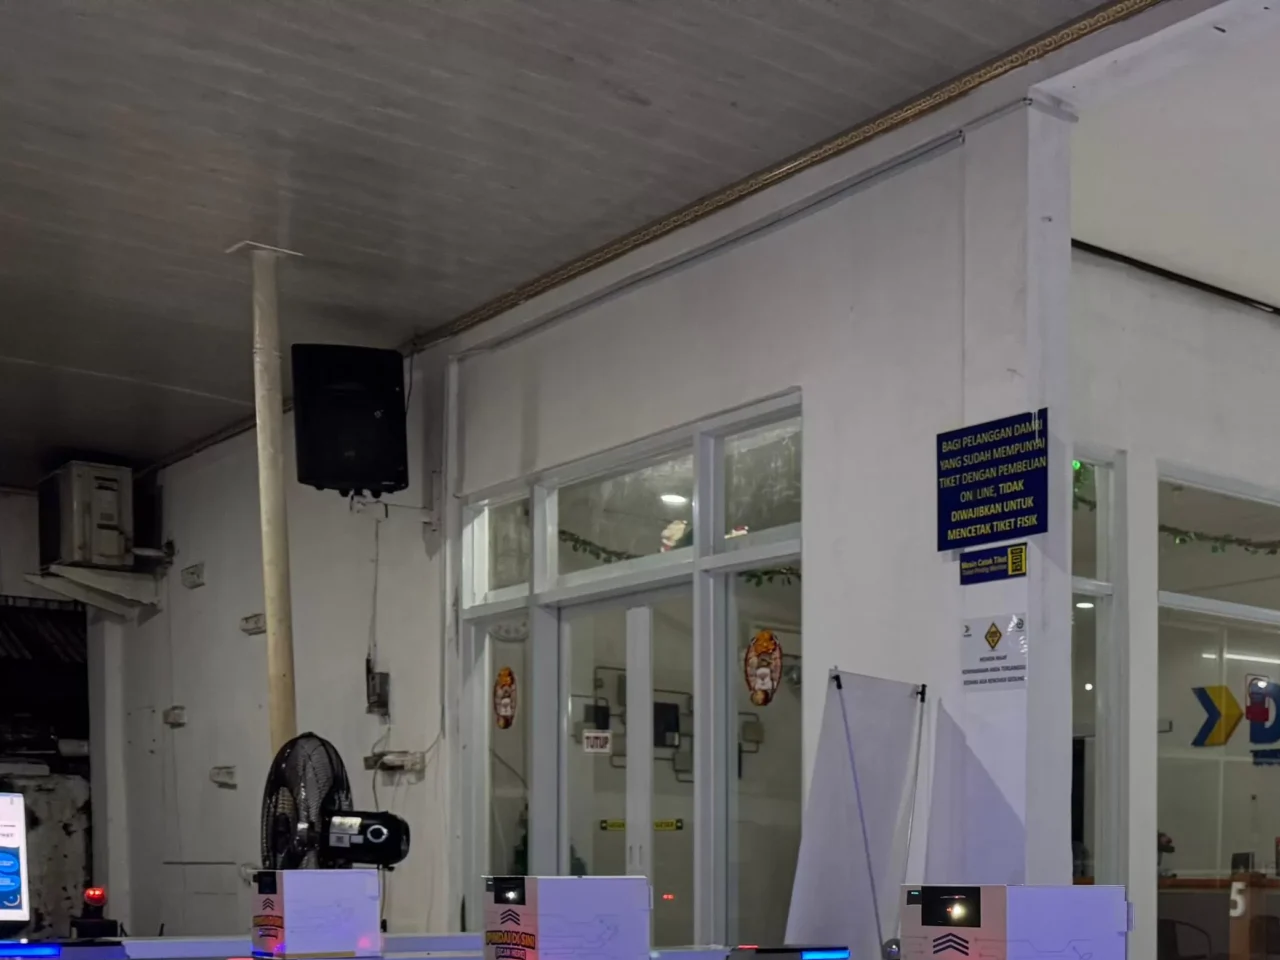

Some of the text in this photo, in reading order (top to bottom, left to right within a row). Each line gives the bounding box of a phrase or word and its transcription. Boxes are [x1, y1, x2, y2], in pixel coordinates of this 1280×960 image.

[942, 439, 961, 453] BAGI
[962, 427, 1013, 448] PELANGGAN
[940, 437, 1045, 471] YANG SUDAH MEMPUNYAI
[939, 456, 1047, 489] TIKET DENGAN PEMBELIAN
[960, 490, 973, 502] ON
[998, 479, 1025, 495] TIDAK
[951, 496, 1034, 522] DIWAJIBKAN UNTUK
[947, 514, 1038, 541] MENCETAK TIKET FISIK
[585, 735, 609, 749] TUTUP
[1229, 881, 1247, 917] 5
